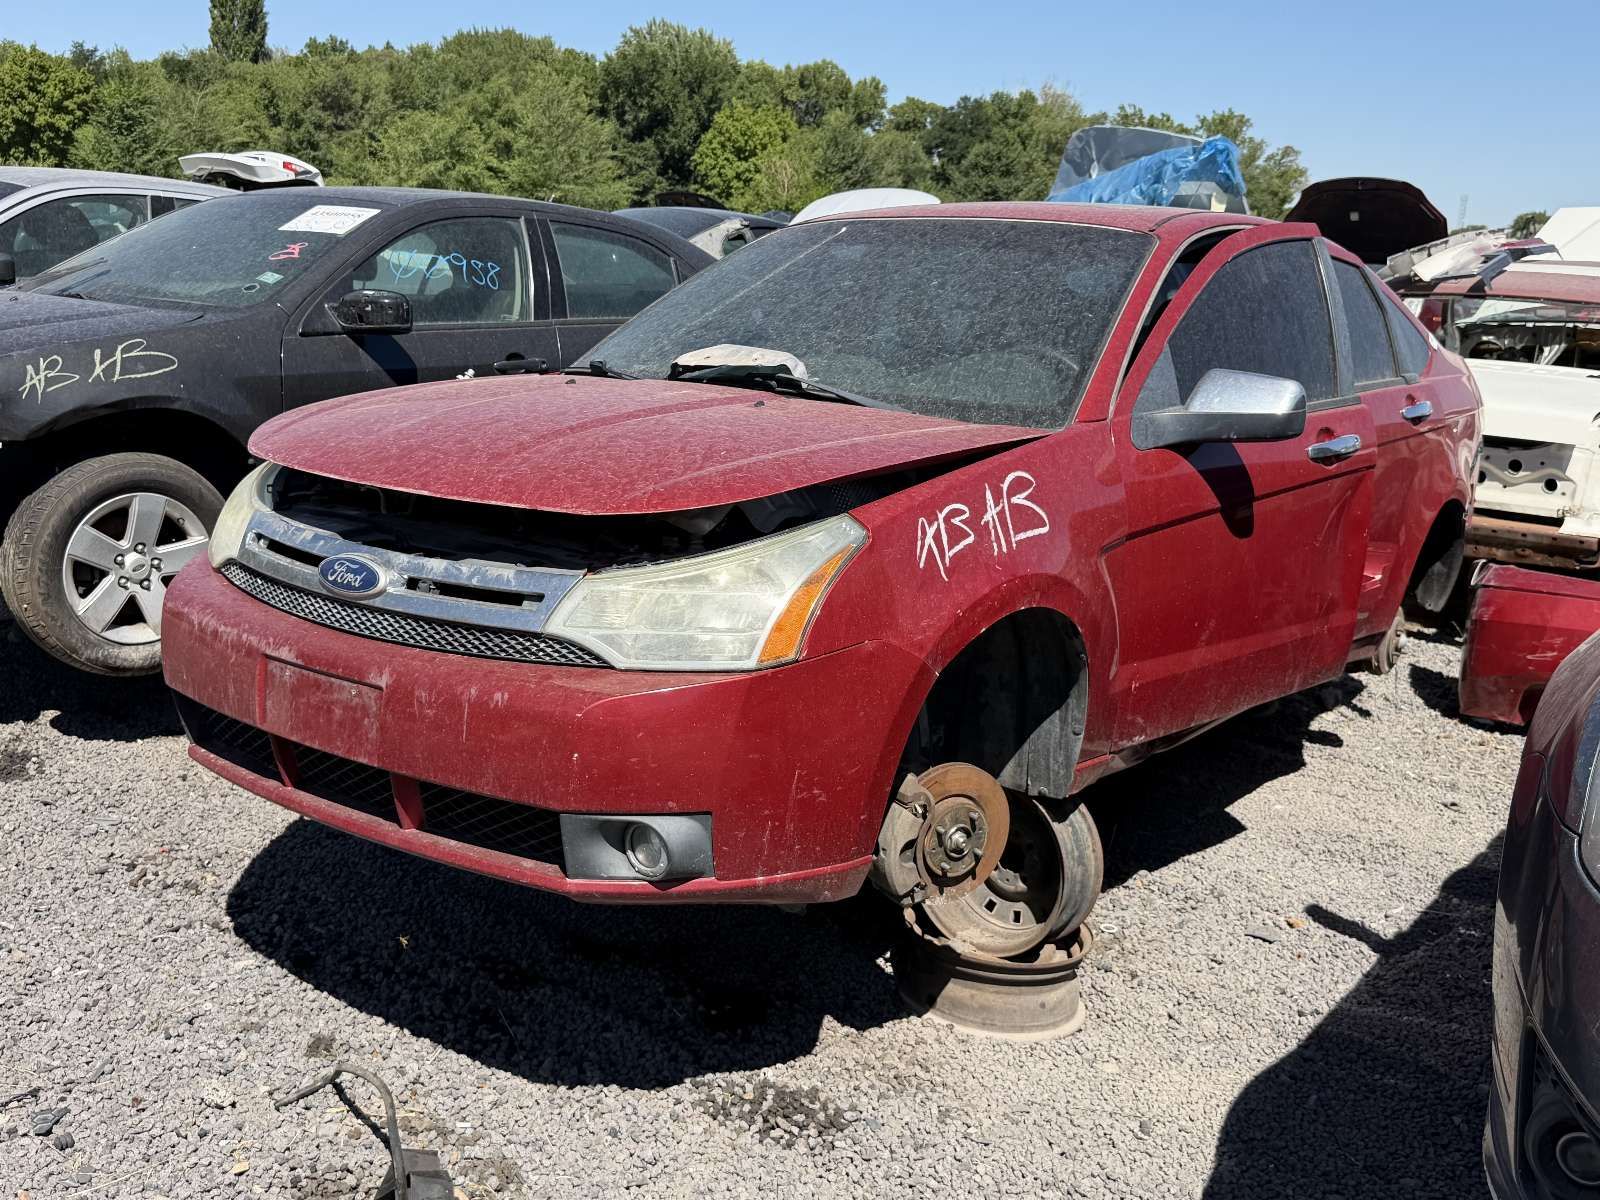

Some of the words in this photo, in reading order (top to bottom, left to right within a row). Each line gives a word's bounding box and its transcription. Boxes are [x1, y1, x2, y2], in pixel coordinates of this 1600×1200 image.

[18, 354, 80, 404] AB
[916, 503, 975, 582] AB
[980, 470, 1050, 556] AB
[327, 560, 367, 588] Ford
